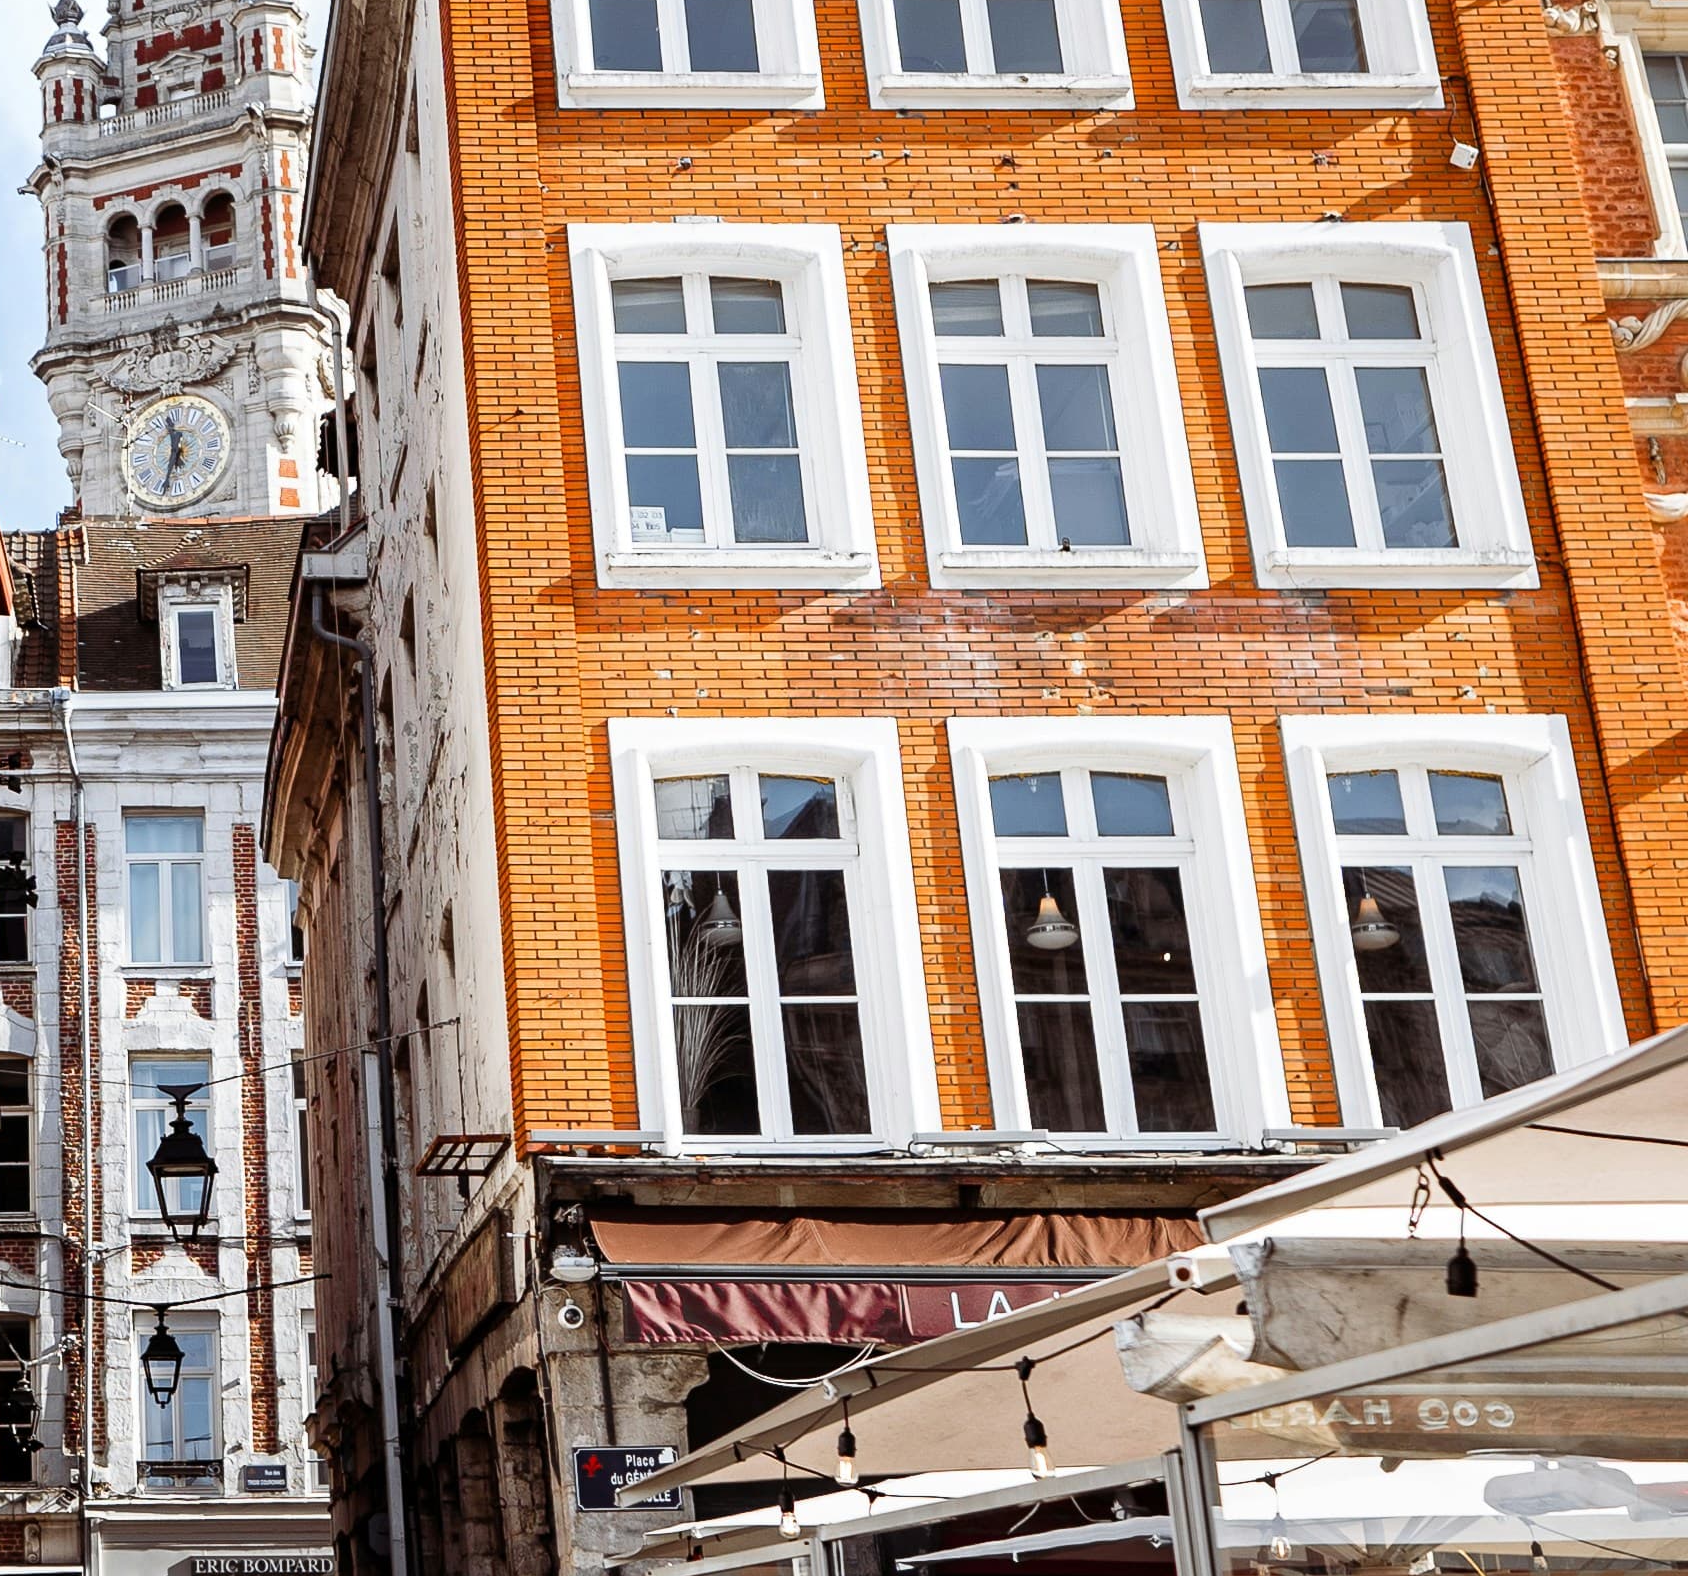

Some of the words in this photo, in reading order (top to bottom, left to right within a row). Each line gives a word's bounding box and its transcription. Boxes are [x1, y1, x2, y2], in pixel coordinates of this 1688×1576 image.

[625, 1454, 655, 1467] Place
[610, 1472, 623, 1485] du
[195, 1558, 239, 1574] ERIC
[243, 1558, 334, 1574] BOMPARD
